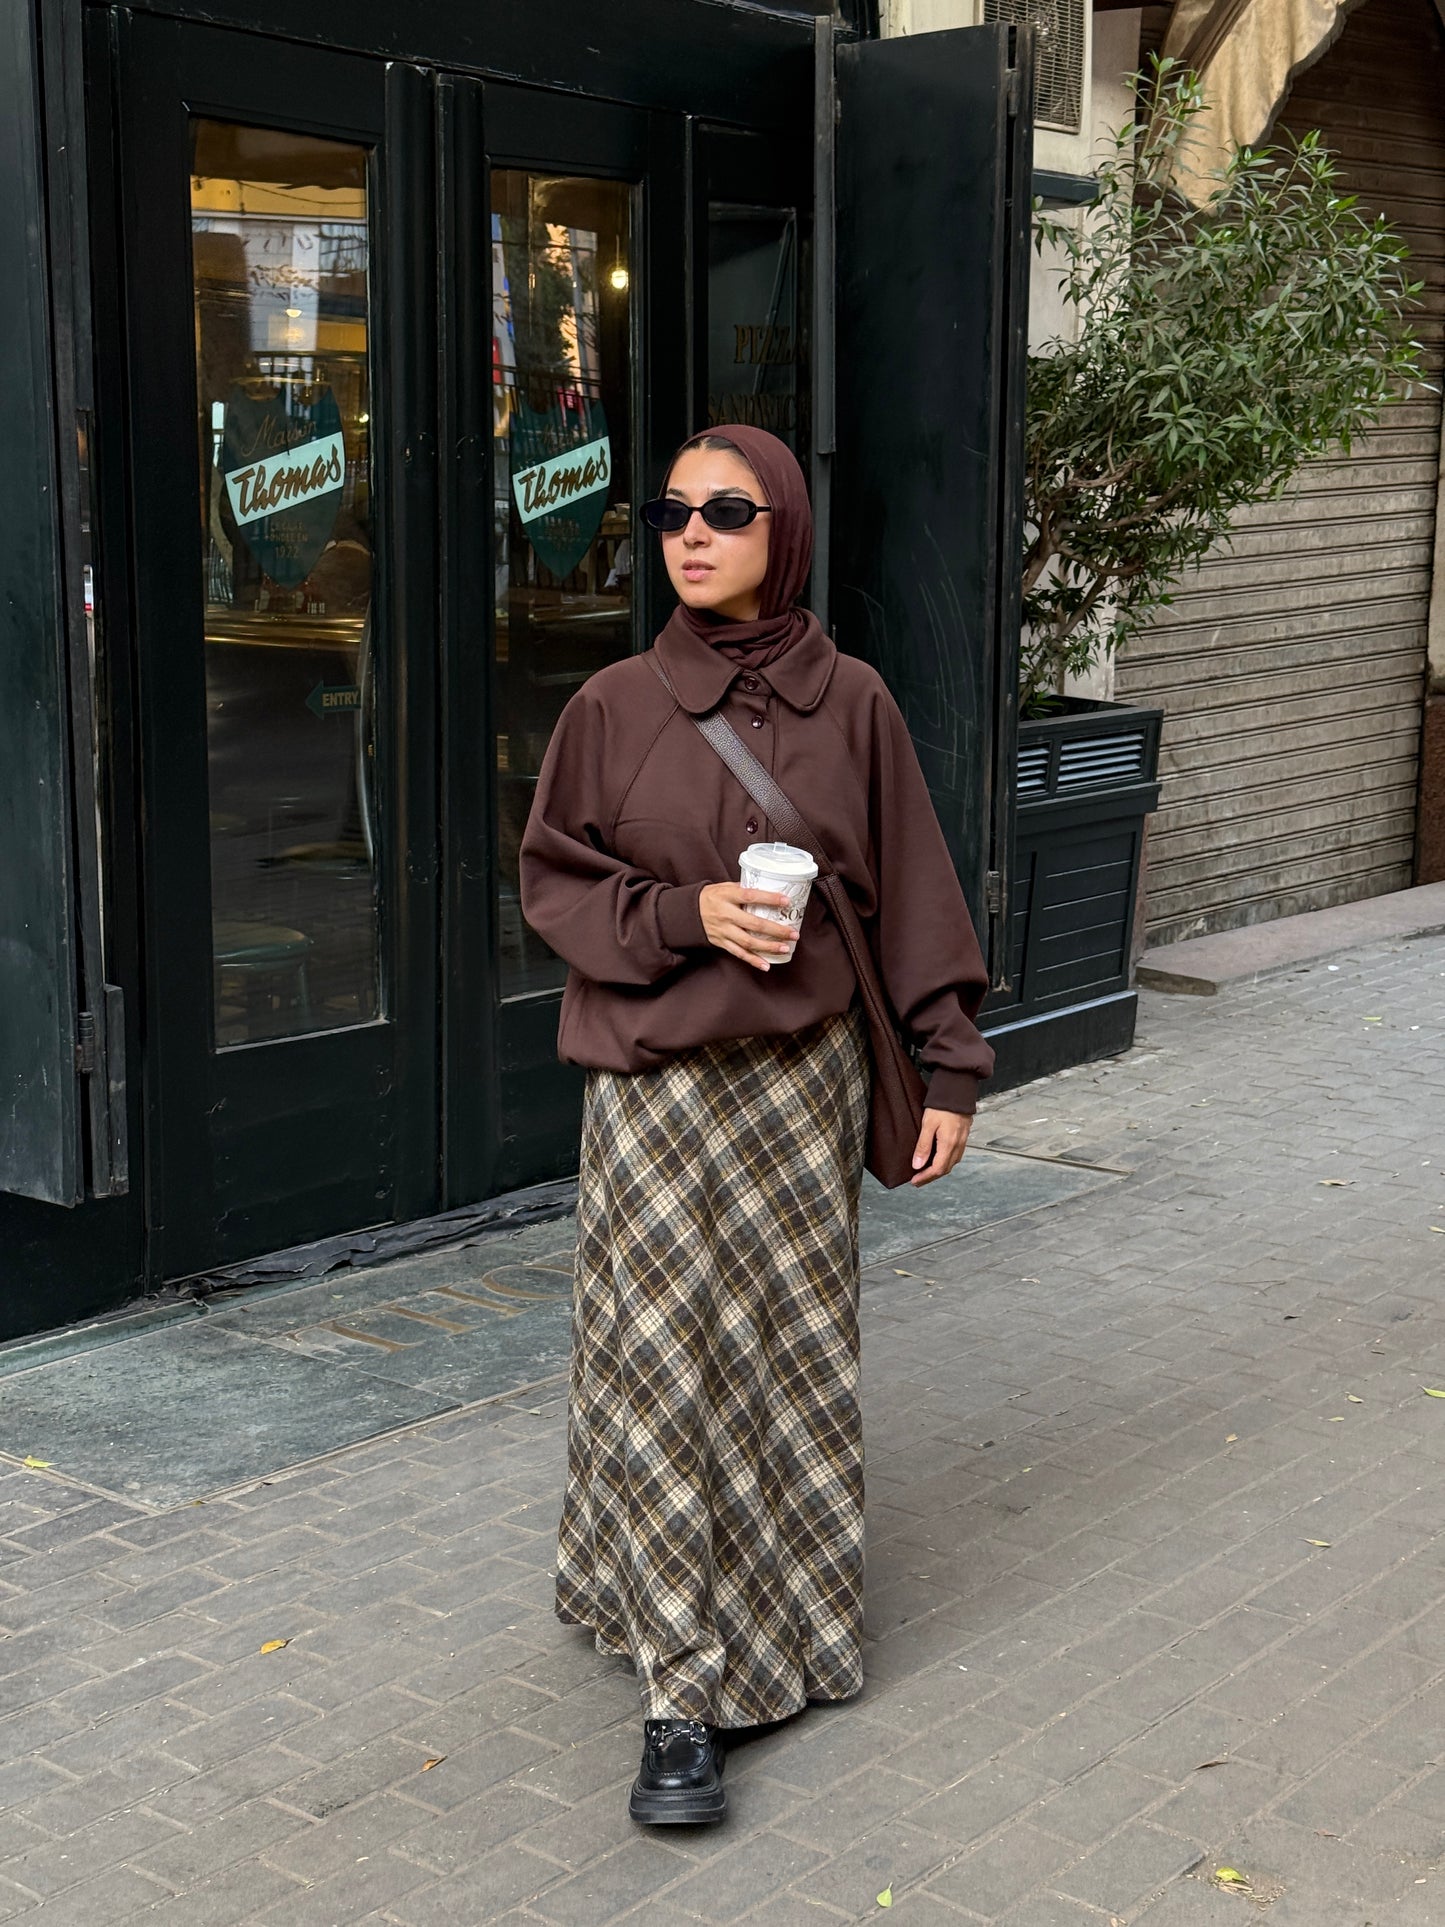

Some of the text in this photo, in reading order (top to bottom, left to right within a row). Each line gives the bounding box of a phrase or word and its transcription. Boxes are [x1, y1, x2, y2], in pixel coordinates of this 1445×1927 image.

[231, 444, 341, 517] Thomas
[517, 446, 608, 514] Thomas
[321, 690, 360, 707] ENTRY
[284, 1251, 574, 1354] THO
